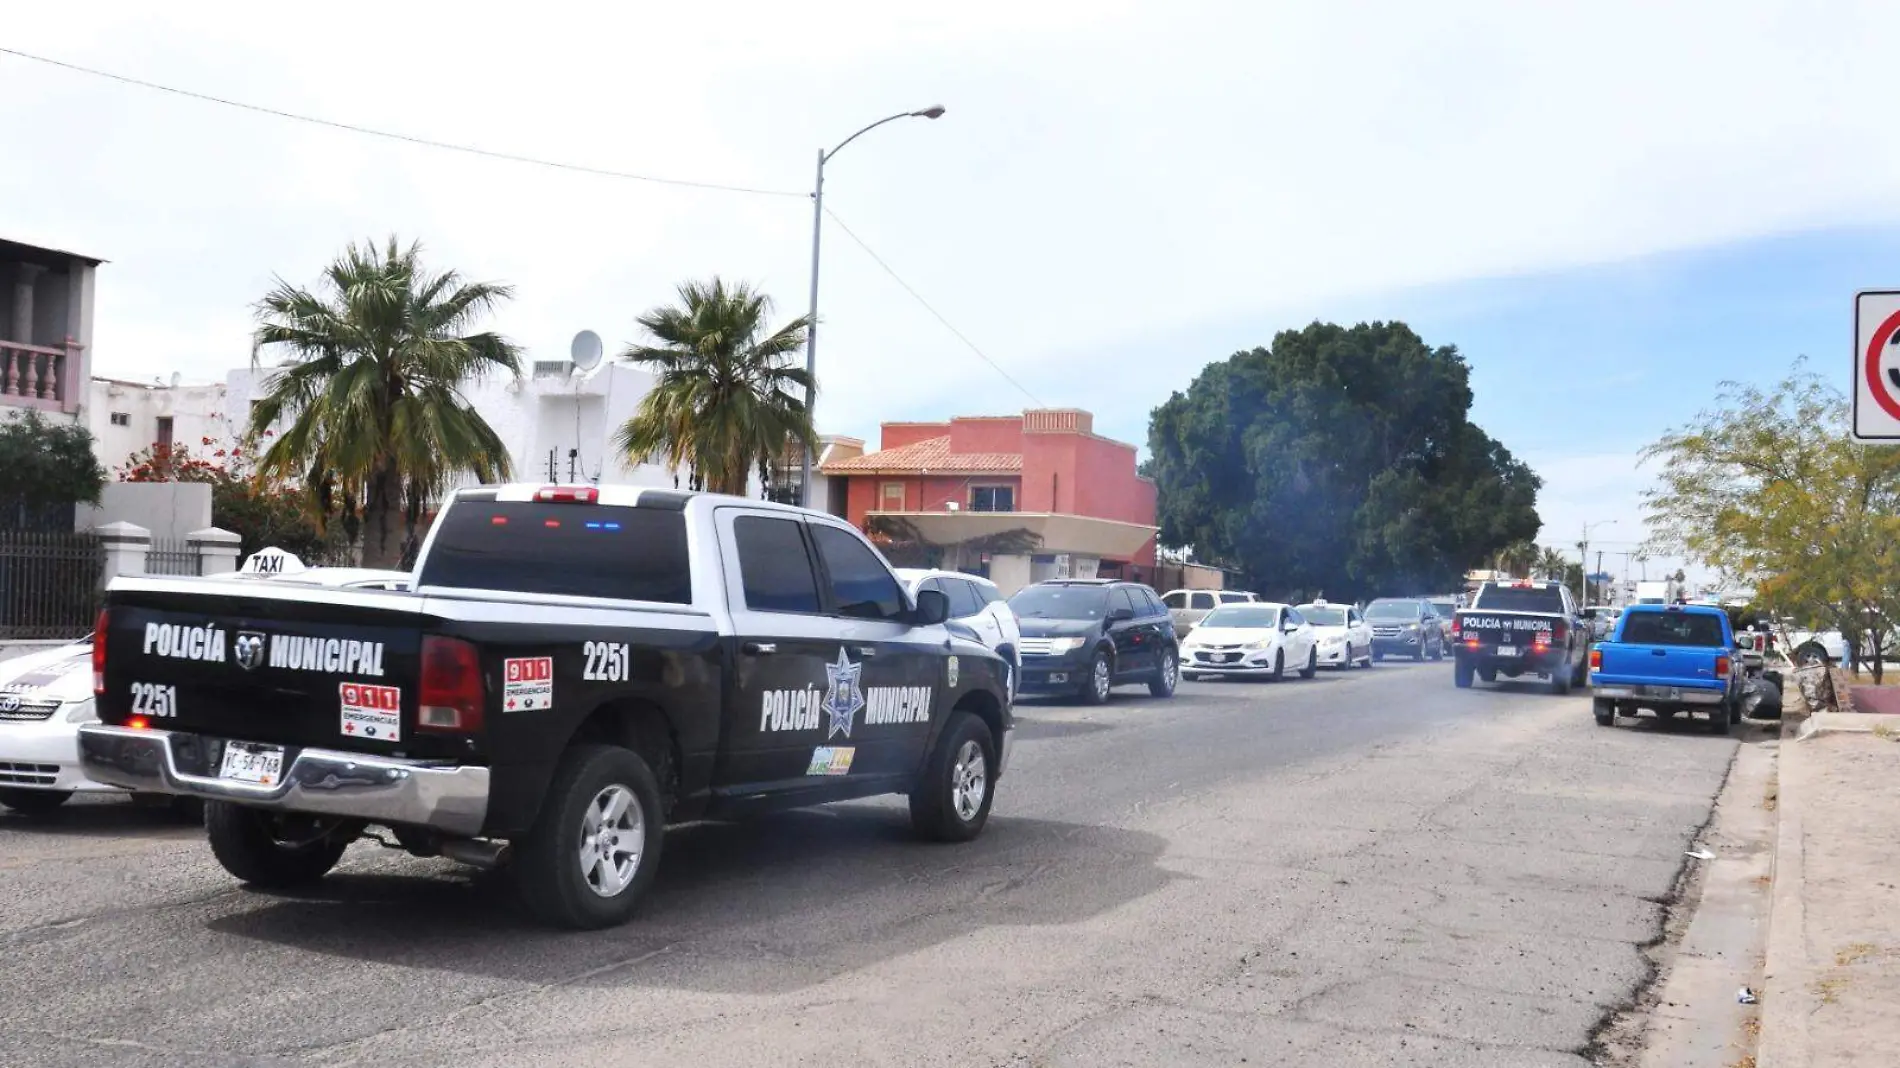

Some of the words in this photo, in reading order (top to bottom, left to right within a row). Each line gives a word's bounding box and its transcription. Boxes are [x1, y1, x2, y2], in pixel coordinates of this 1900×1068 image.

[253, 555, 284, 573] TAXI
[1513, 619, 1552, 631] MUNICIPAL
[144, 622, 226, 662] POLICÍA
[269, 635, 384, 676] MUNICIPAL
[510, 661, 547, 679] 911
[583, 640, 629, 681] 2251
[131, 681, 177, 718] 2251
[345, 687, 393, 708] 911
[506, 686, 550, 697] EMERGENCIAS
[760, 682, 820, 731] POLICÍA
[865, 686, 931, 724] MUNICIPAL
[343, 711, 398, 726] EMERGENCIAS
